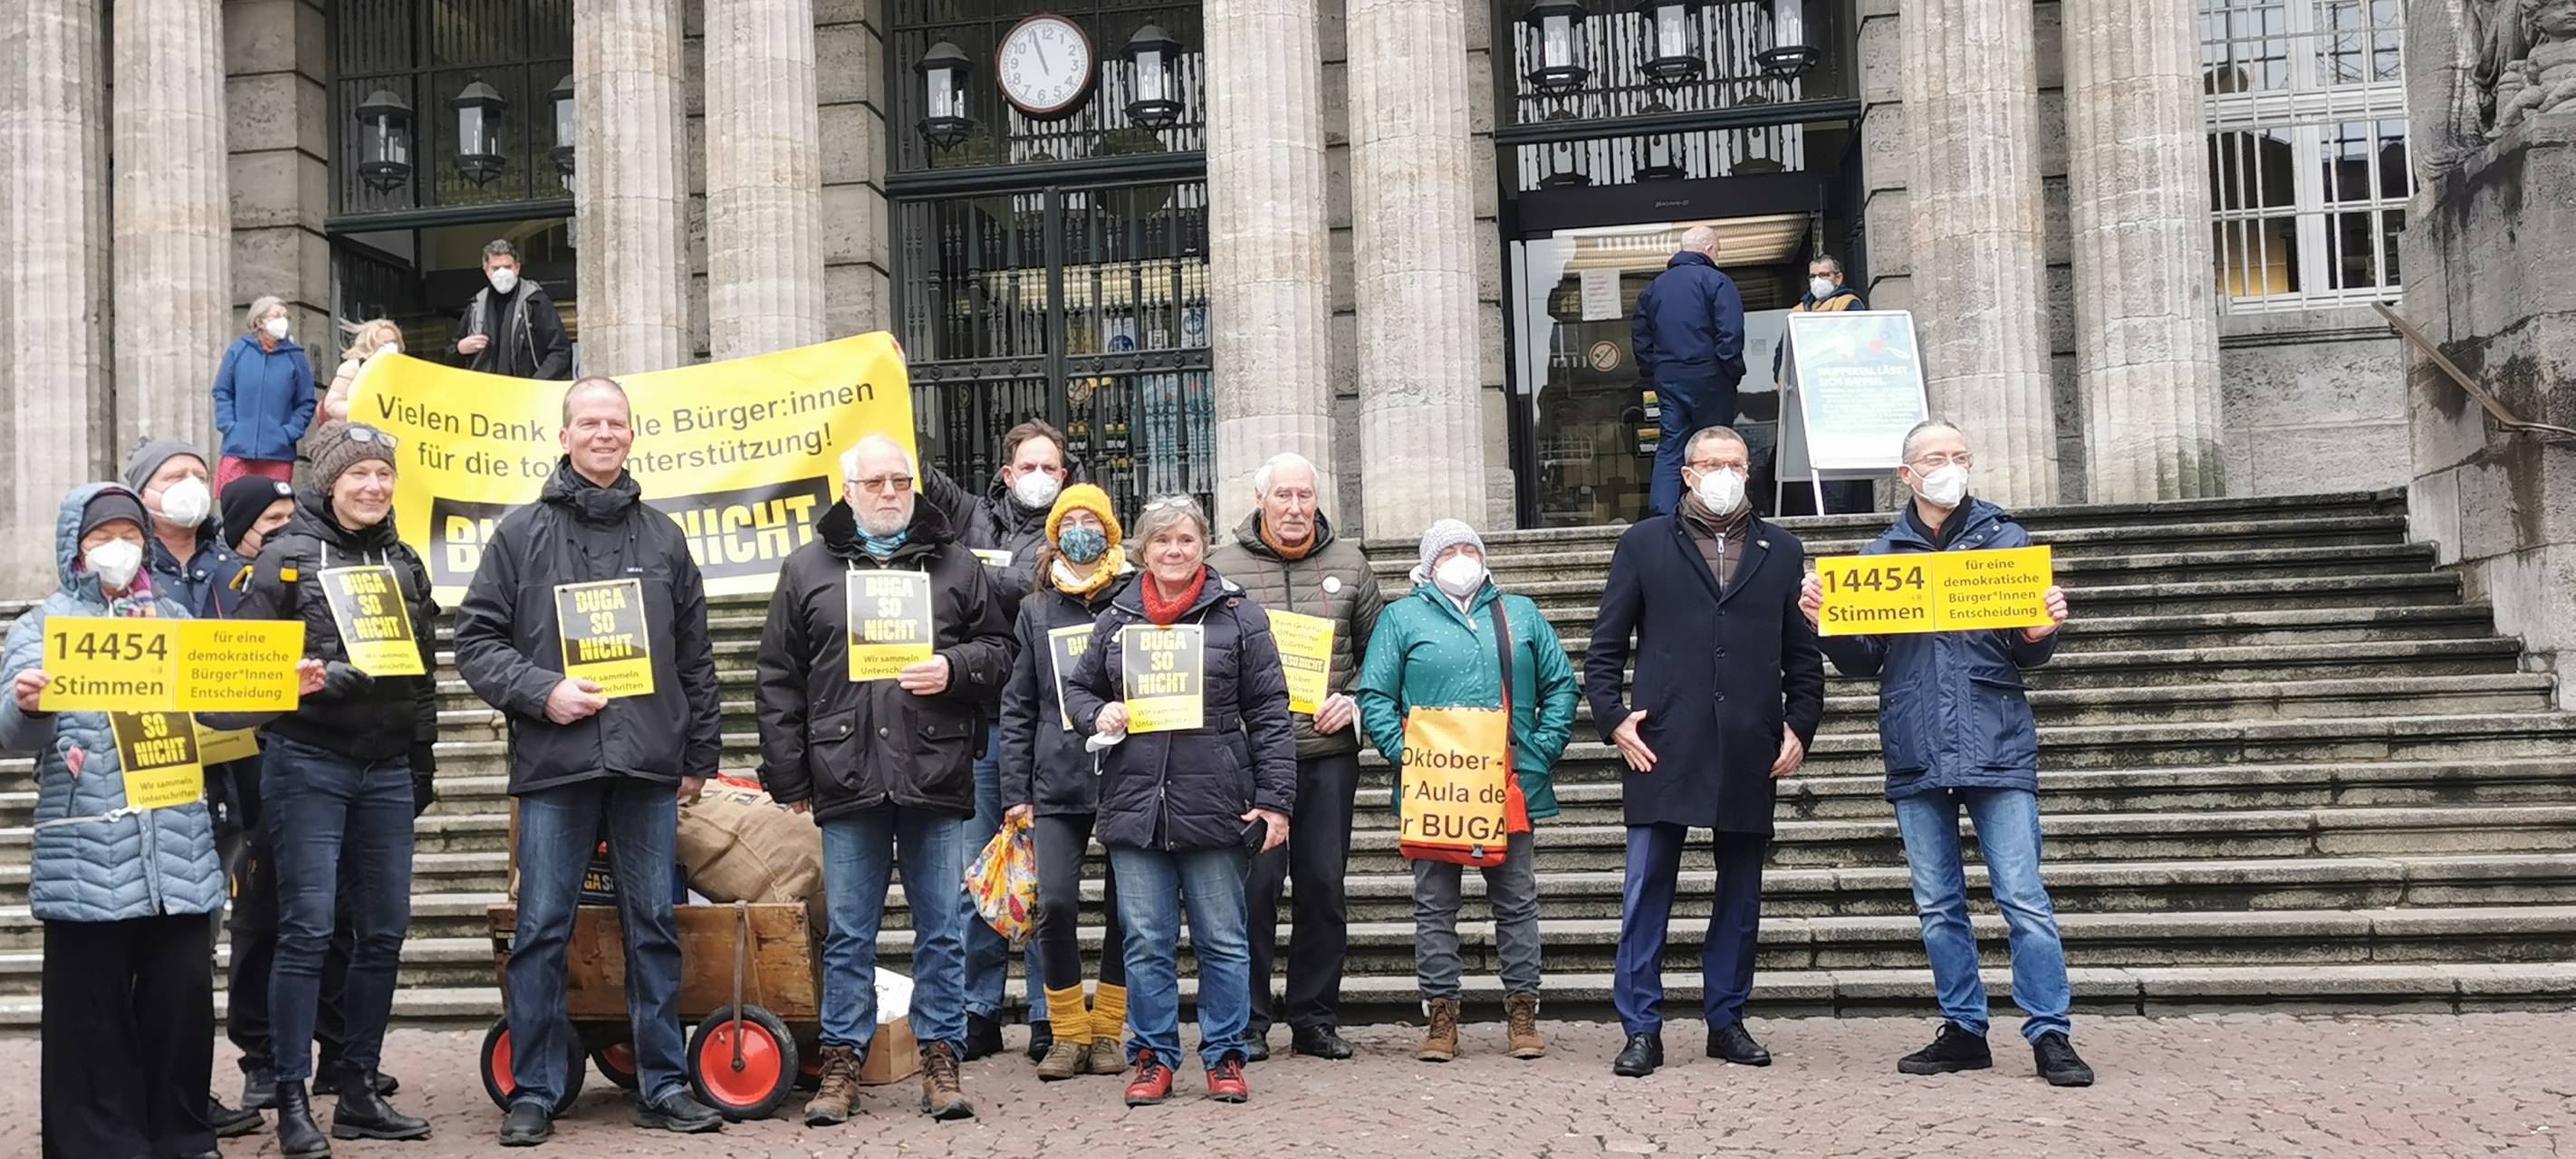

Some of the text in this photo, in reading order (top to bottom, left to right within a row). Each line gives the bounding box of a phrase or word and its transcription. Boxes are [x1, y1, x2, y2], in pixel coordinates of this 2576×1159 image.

[377, 382, 874, 442] Vielen Dank le Bürger:innen
[418, 422, 832, 478] für die tol nterstützung!
[674, 494, 816, 567] NICHT
[1966, 559, 2014, 570] für eine
[338, 572, 388, 596] BUGA
[865, 577, 914, 598] BUGA
[1824, 566, 1925, 593] 14454
[1944, 573, 2040, 587] demokratische
[358, 594, 382, 616] SO
[574, 588, 627, 613] BUGA
[878, 597, 902, 618] SO
[590, 611, 616, 635] SO
[1828, 605, 1925, 622] Stimmen
[1949, 606, 2037, 619] Entscheidung
[214, 630, 265, 643] für eine
[352, 616, 400, 639] NICHT
[864, 619, 918, 641] NICHT
[53, 632, 168, 661] 14454
[578, 634, 634, 661] NICHT
[1066, 635, 1088, 656] BU
[1140, 631, 1187, 651] BUGA
[187, 649, 289, 662] demokratische
[880, 654, 919, 663] sammeln
[1150, 651, 1175, 672] SO
[53, 675, 164, 695] Stimmen
[599, 670, 639, 682] sammeln
[1138, 672, 1189, 695] NICHT
[190, 686, 283, 701] Entscheidung
[599, 682, 644, 694] rschriften
[140, 713, 168, 739] SO
[133, 737, 187, 768] NICHT
[1402, 747, 1490, 771] Oktober
[139, 781, 154, 791] Wir
[1415, 781, 1469, 803] Aula
[138, 790, 197, 805] Unterschriften
[1422, 813, 1505, 840] BUGA
